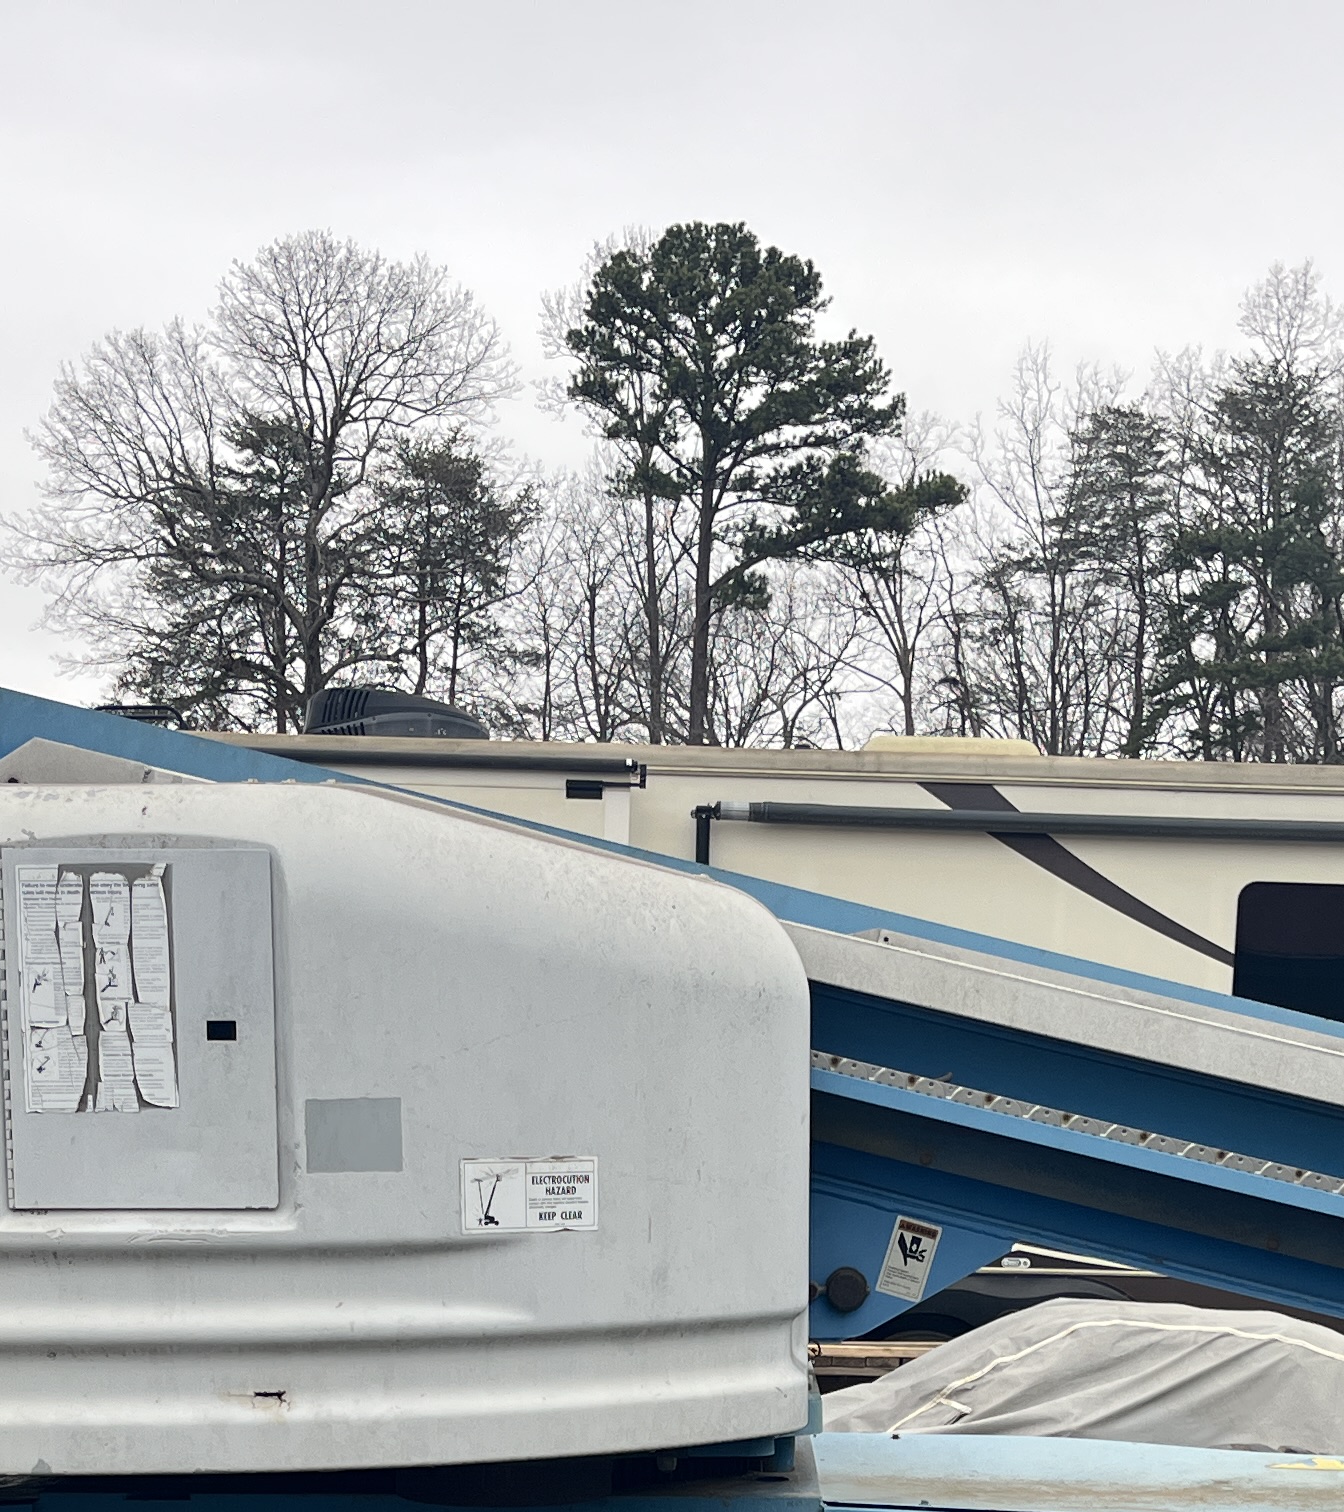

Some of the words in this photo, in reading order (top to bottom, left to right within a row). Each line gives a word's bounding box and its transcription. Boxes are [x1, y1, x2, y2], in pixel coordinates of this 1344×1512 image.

[531, 1174, 590, 1185] ELECTROCUTION
[545, 1186, 577, 1195] HAZARD
[538, 1211, 557, 1221] KEEP
[560, 1210, 583, 1220] CLEAR
